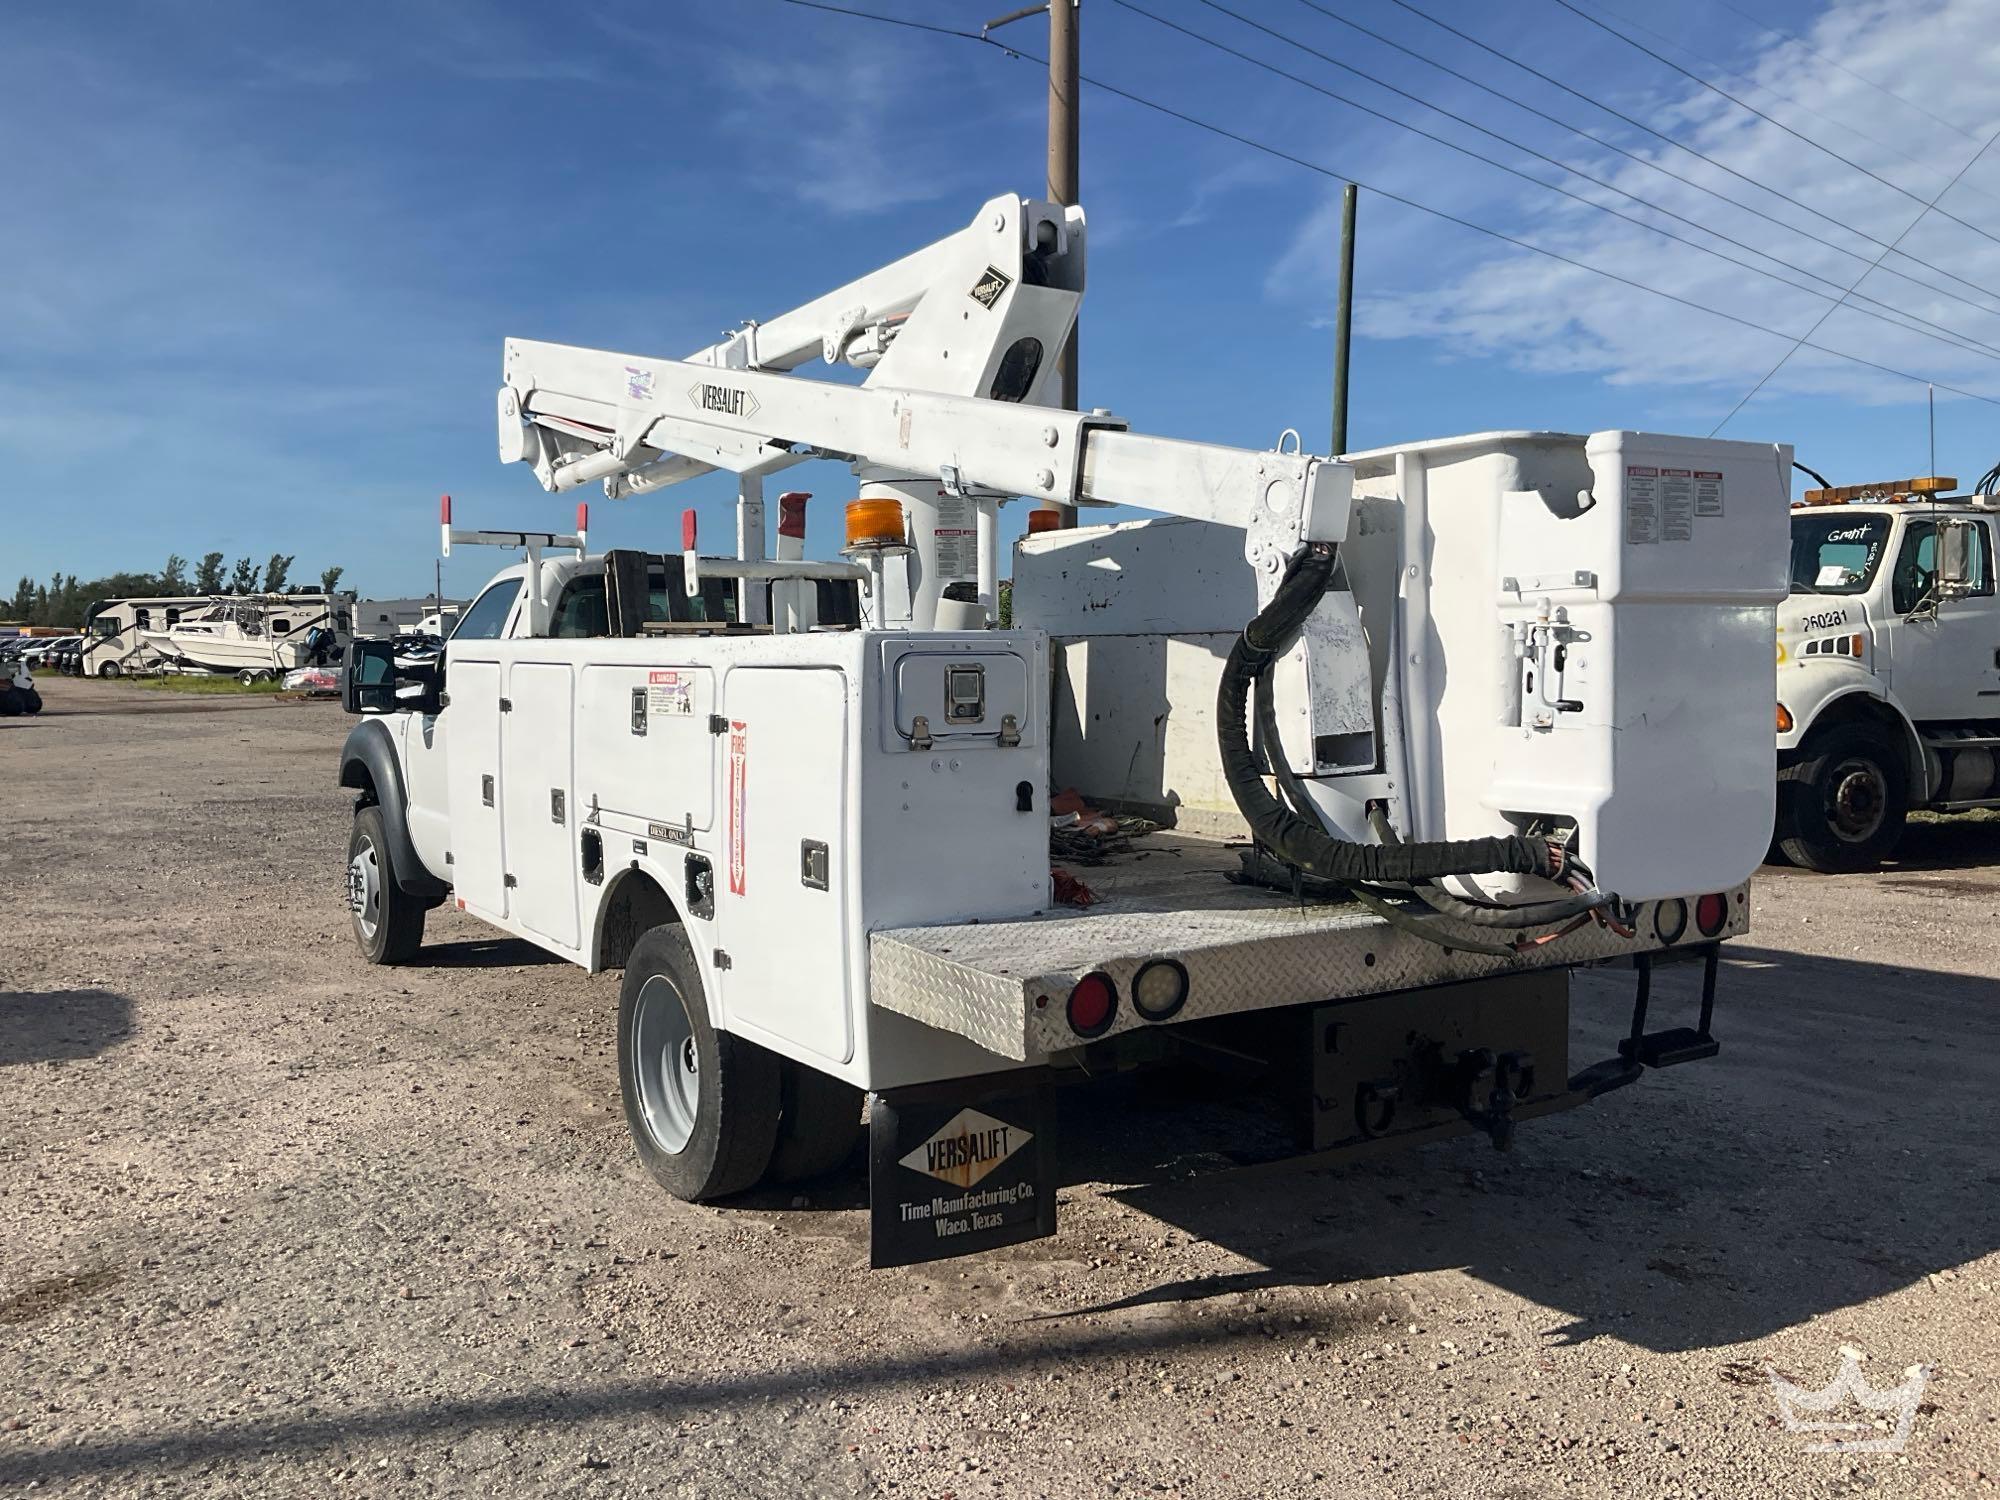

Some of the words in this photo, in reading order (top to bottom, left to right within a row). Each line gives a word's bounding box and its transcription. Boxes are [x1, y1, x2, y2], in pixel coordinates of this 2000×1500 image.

[702, 384, 745, 416] VERSALIFT
[656, 673, 676, 683] DANGER
[731, 735, 746, 754] FIRE
[926, 1127, 1009, 1172] VERSALIFT
[900, 1203, 931, 1222] Time
[932, 1186, 1017, 1216] Manufacturing
[1018, 1182, 1034, 1199] Co.
[971, 1212, 1003, 1231] Texas
